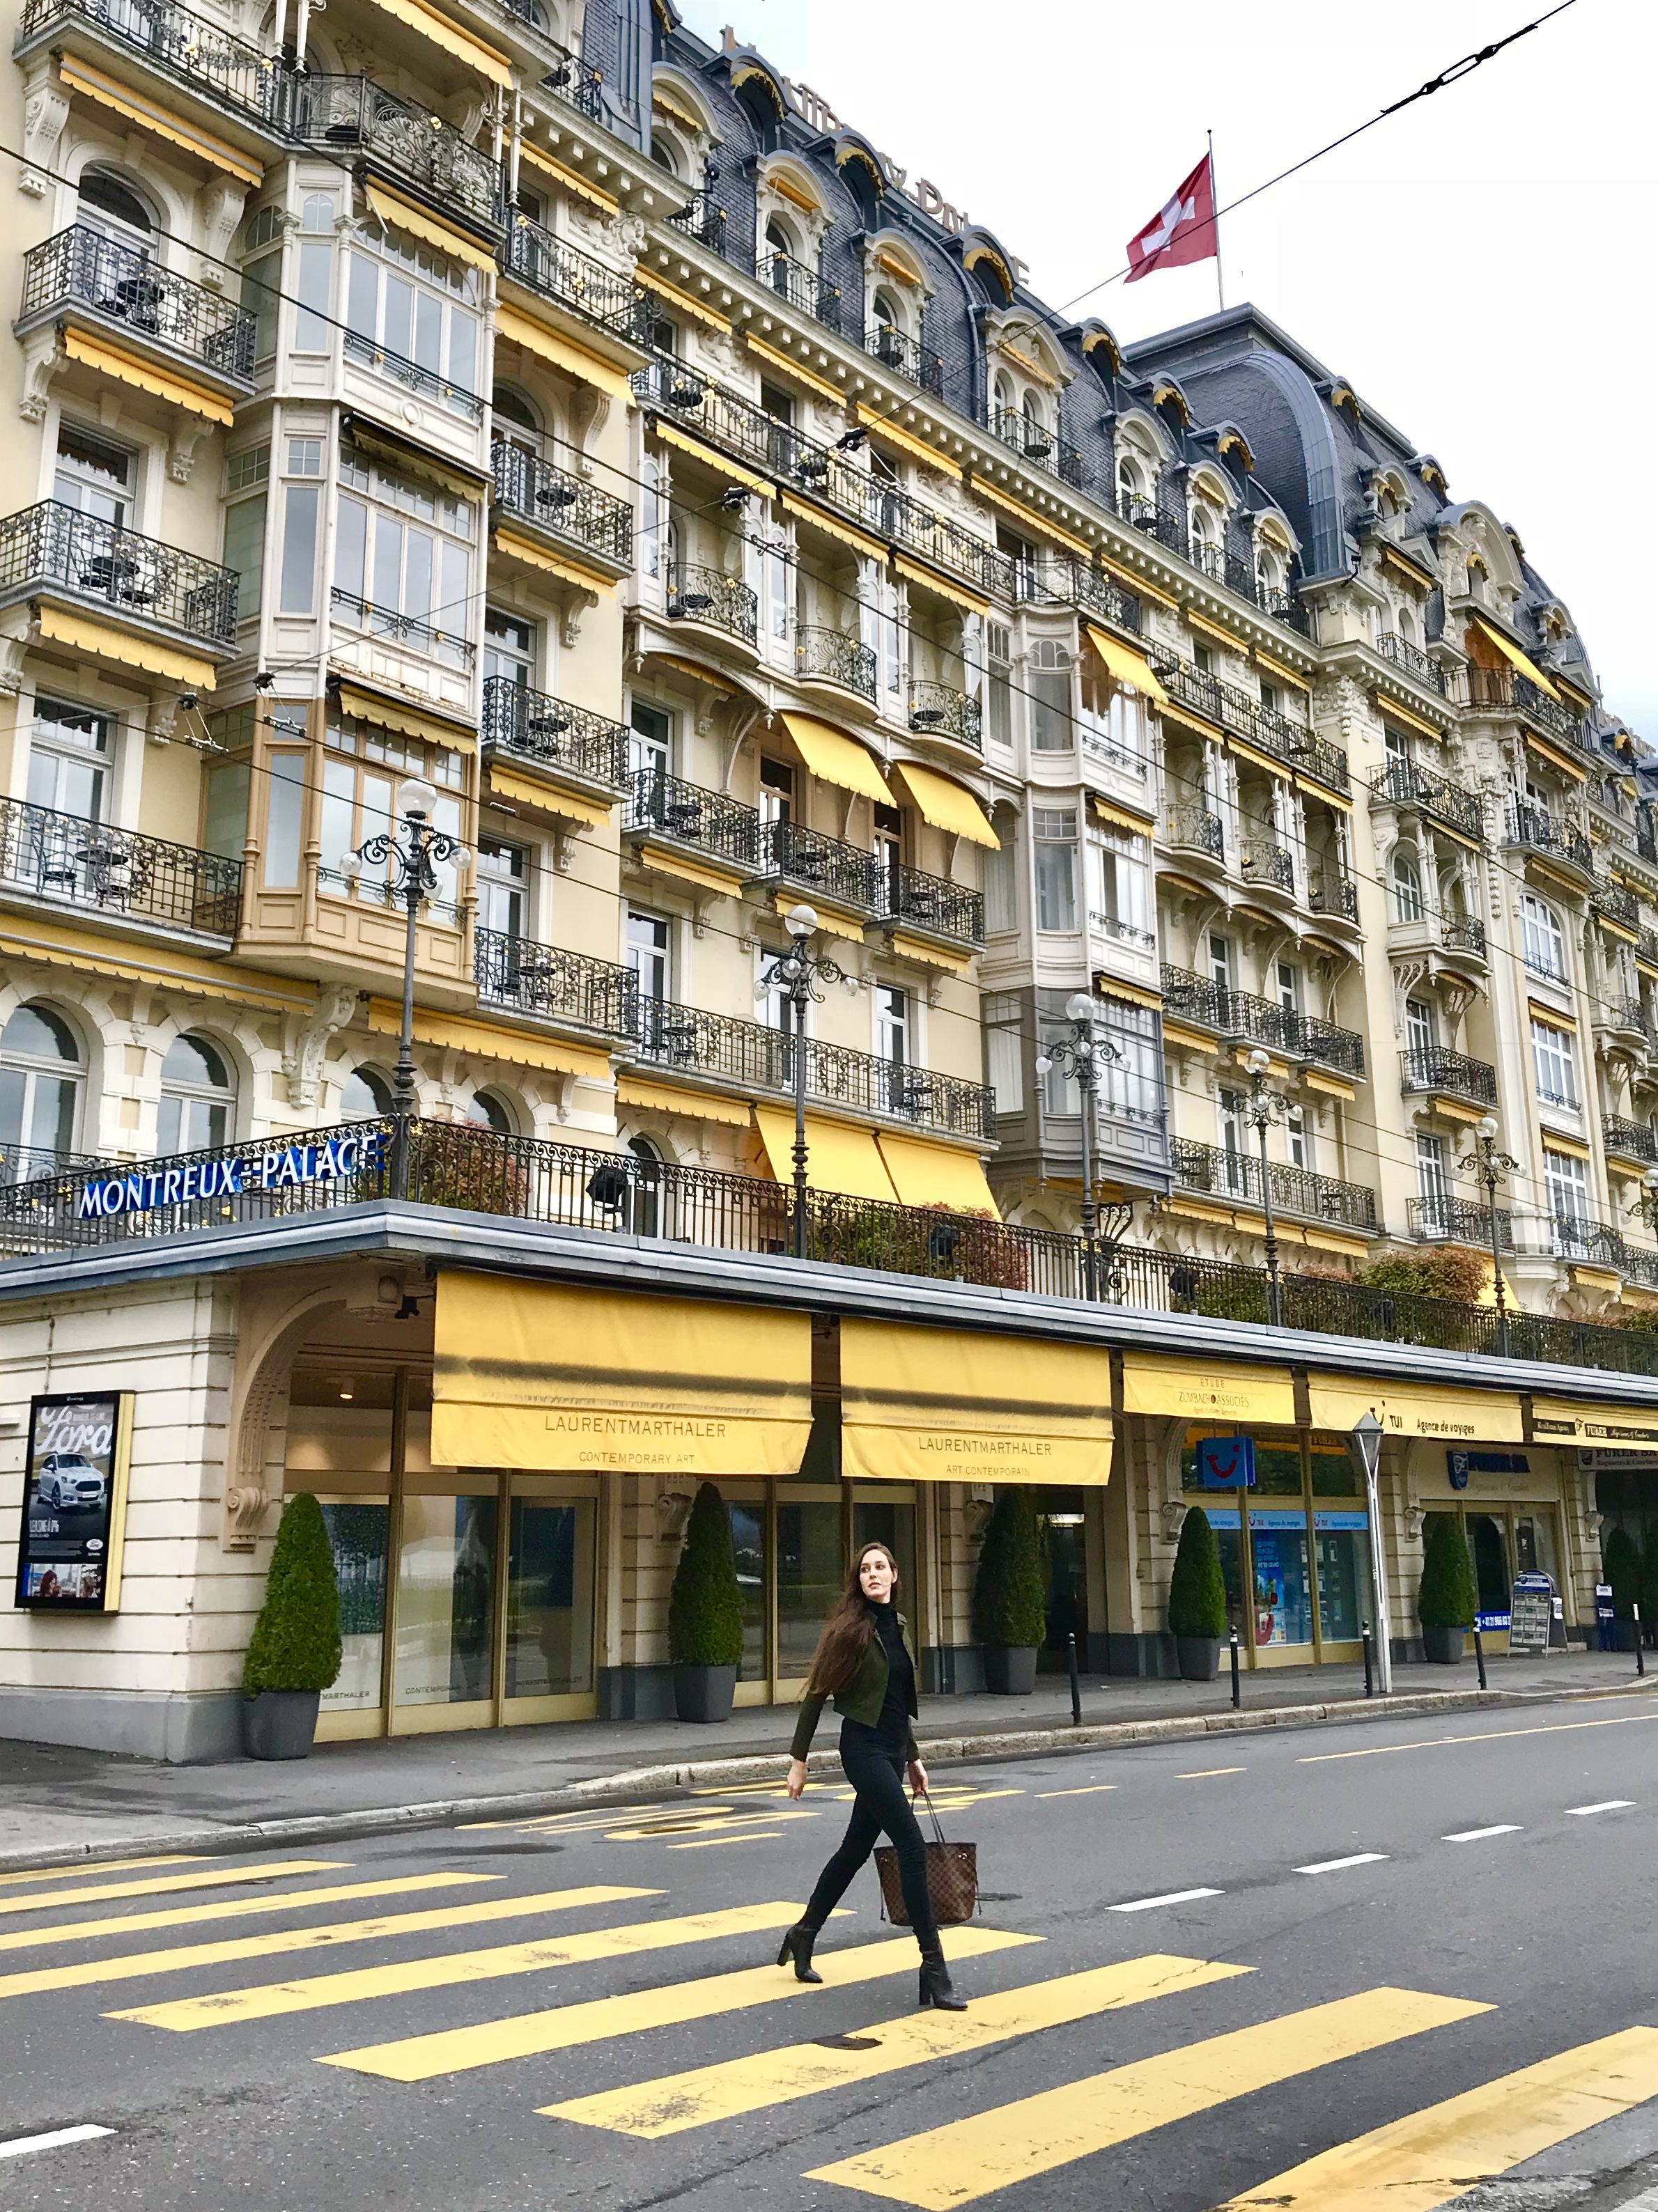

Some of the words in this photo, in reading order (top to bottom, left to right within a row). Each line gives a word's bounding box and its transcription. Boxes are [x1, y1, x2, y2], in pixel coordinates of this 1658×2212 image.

[545, 1415, 726, 1438] LAURENTMARTHALER
[1389, 1415, 1403, 1428] TUI
[1417, 1418, 1439, 1434] Agence
[1441, 1420, 1449, 1432] de
[919, 1437, 1052, 1456] LAURENTMARTHALER
[579, 1451, 672, 1465] CONTEMPORARY
[676, 1453, 695, 1465] ART
[946, 1465, 961, 1474] ART
[966, 1465, 1031, 1477] CONTEMPORAIN
